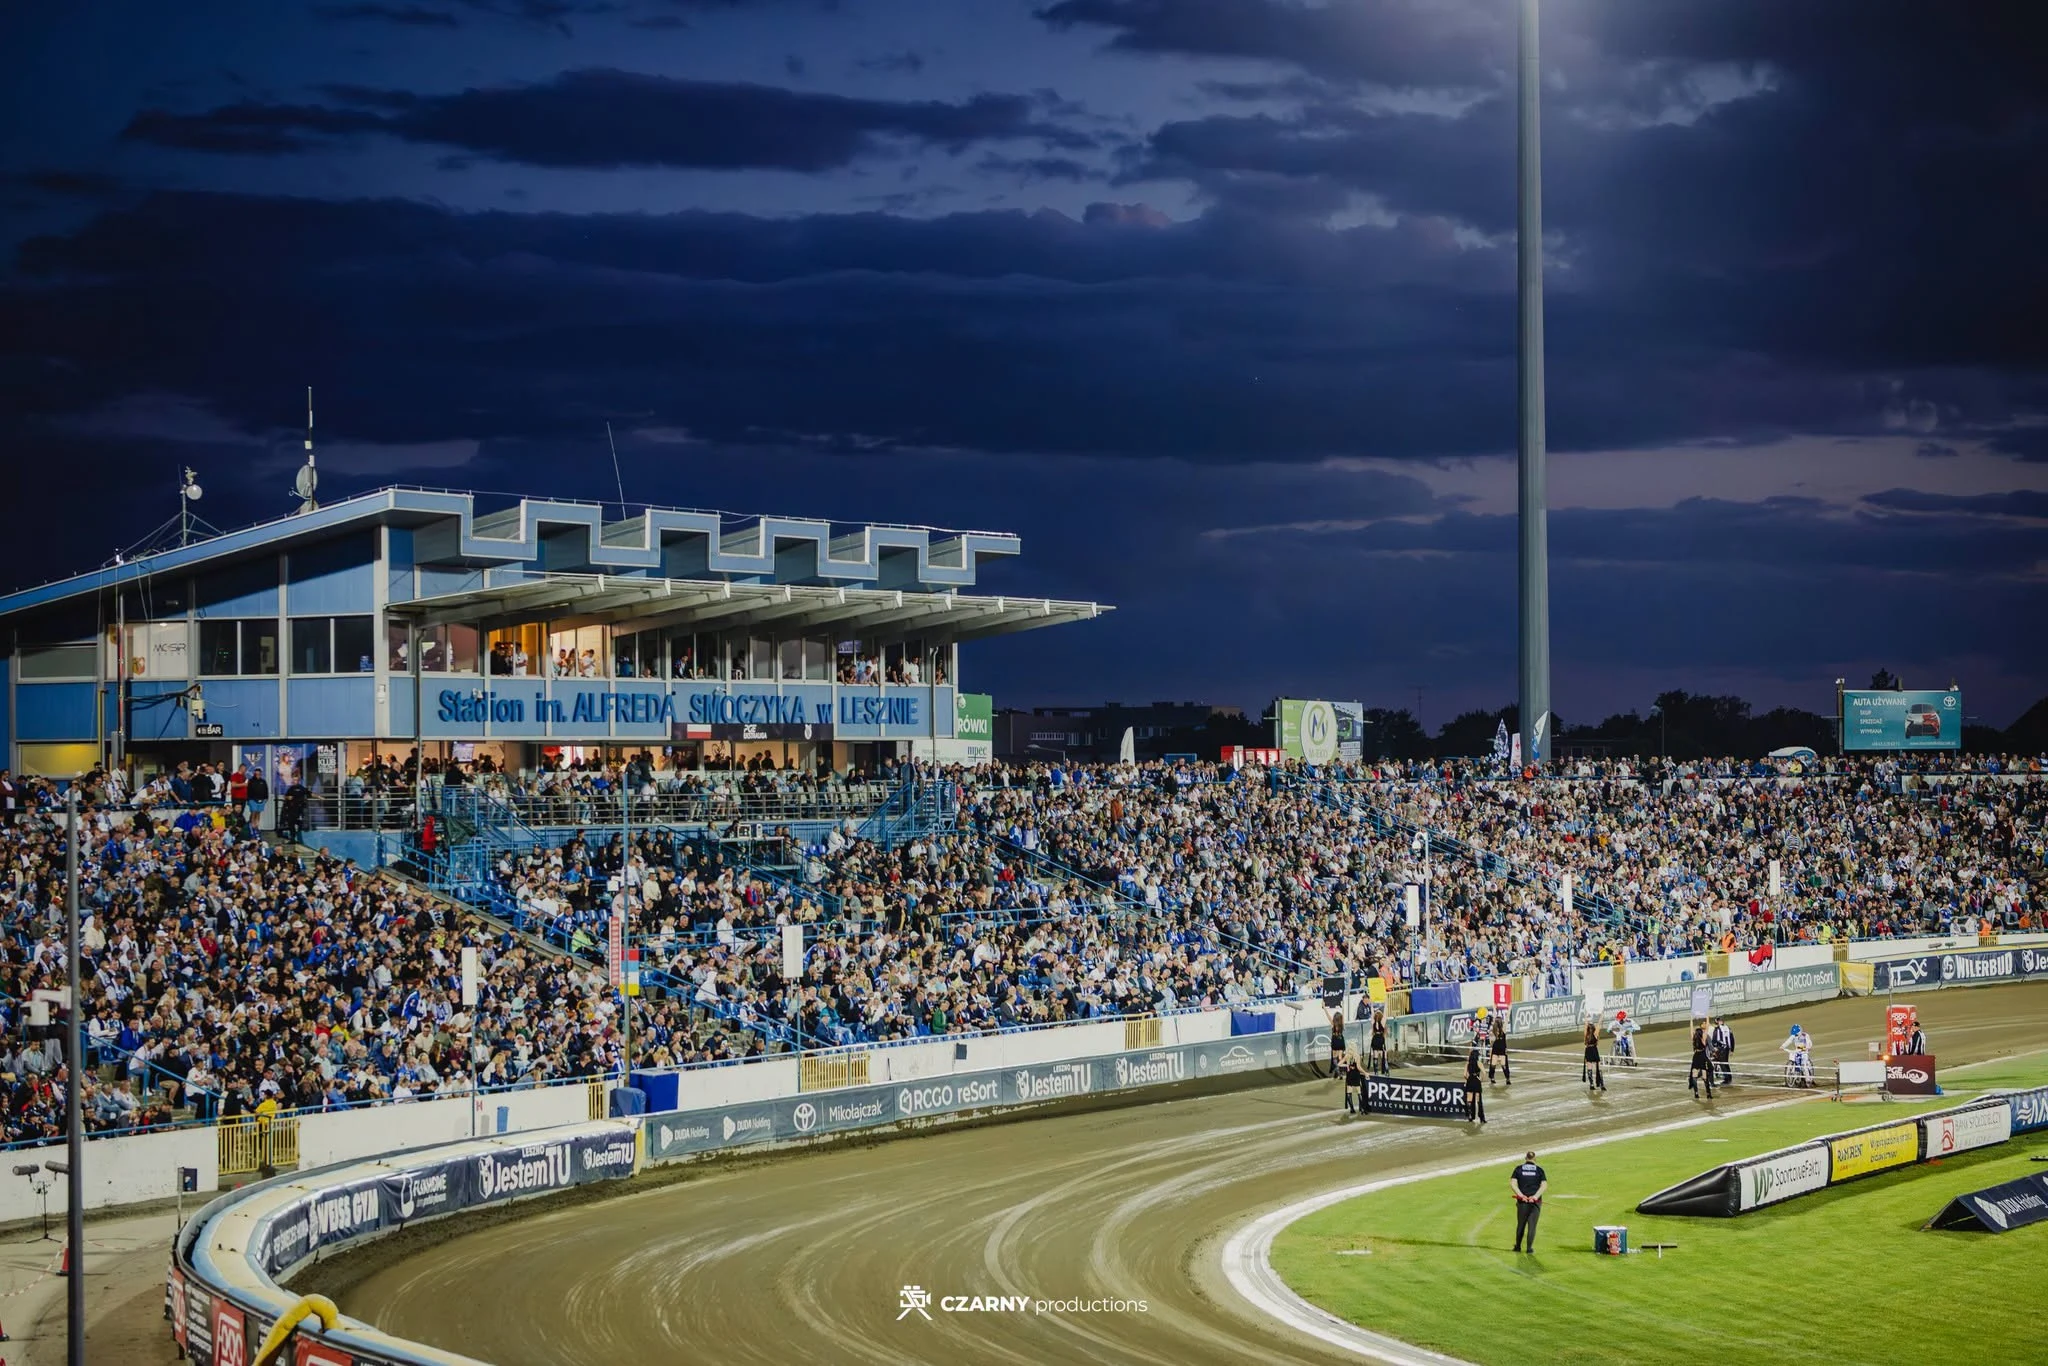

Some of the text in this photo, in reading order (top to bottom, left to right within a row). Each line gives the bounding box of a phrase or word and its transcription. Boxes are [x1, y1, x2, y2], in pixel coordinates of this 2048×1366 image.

[438, 689, 920, 725] Stadion im. ALFREDA SMOCZYKA w LESZNIE
[1853, 696, 1907, 706] AUTA UŻYWANE
[1955, 951, 2014, 979] WILERBUD
[1714, 978, 1745, 993] AGREGATY
[1794, 970, 1834, 989] RCGO reSort
[1659, 986, 1691, 1002] AGREGATY
[1540, 1001, 1576, 1017] AGREGATY
[1129, 1052, 1184, 1083] JestemTU
[1030, 1063, 1092, 1098] JestemTU
[914, 1079, 998, 1111] RCGO reSort
[829, 1100, 883, 1122] Mikołajczak
[674, 1126, 710, 1140] DUDA Holding
[736, 1117, 771, 1131] DUDA Holding
[522, 1145, 545, 1158] LESZNO
[592, 1142, 634, 1169] JestemTU
[494, 1144, 571, 1194] JestemTU
[317, 1188, 379, 1235] WEISS GYM
